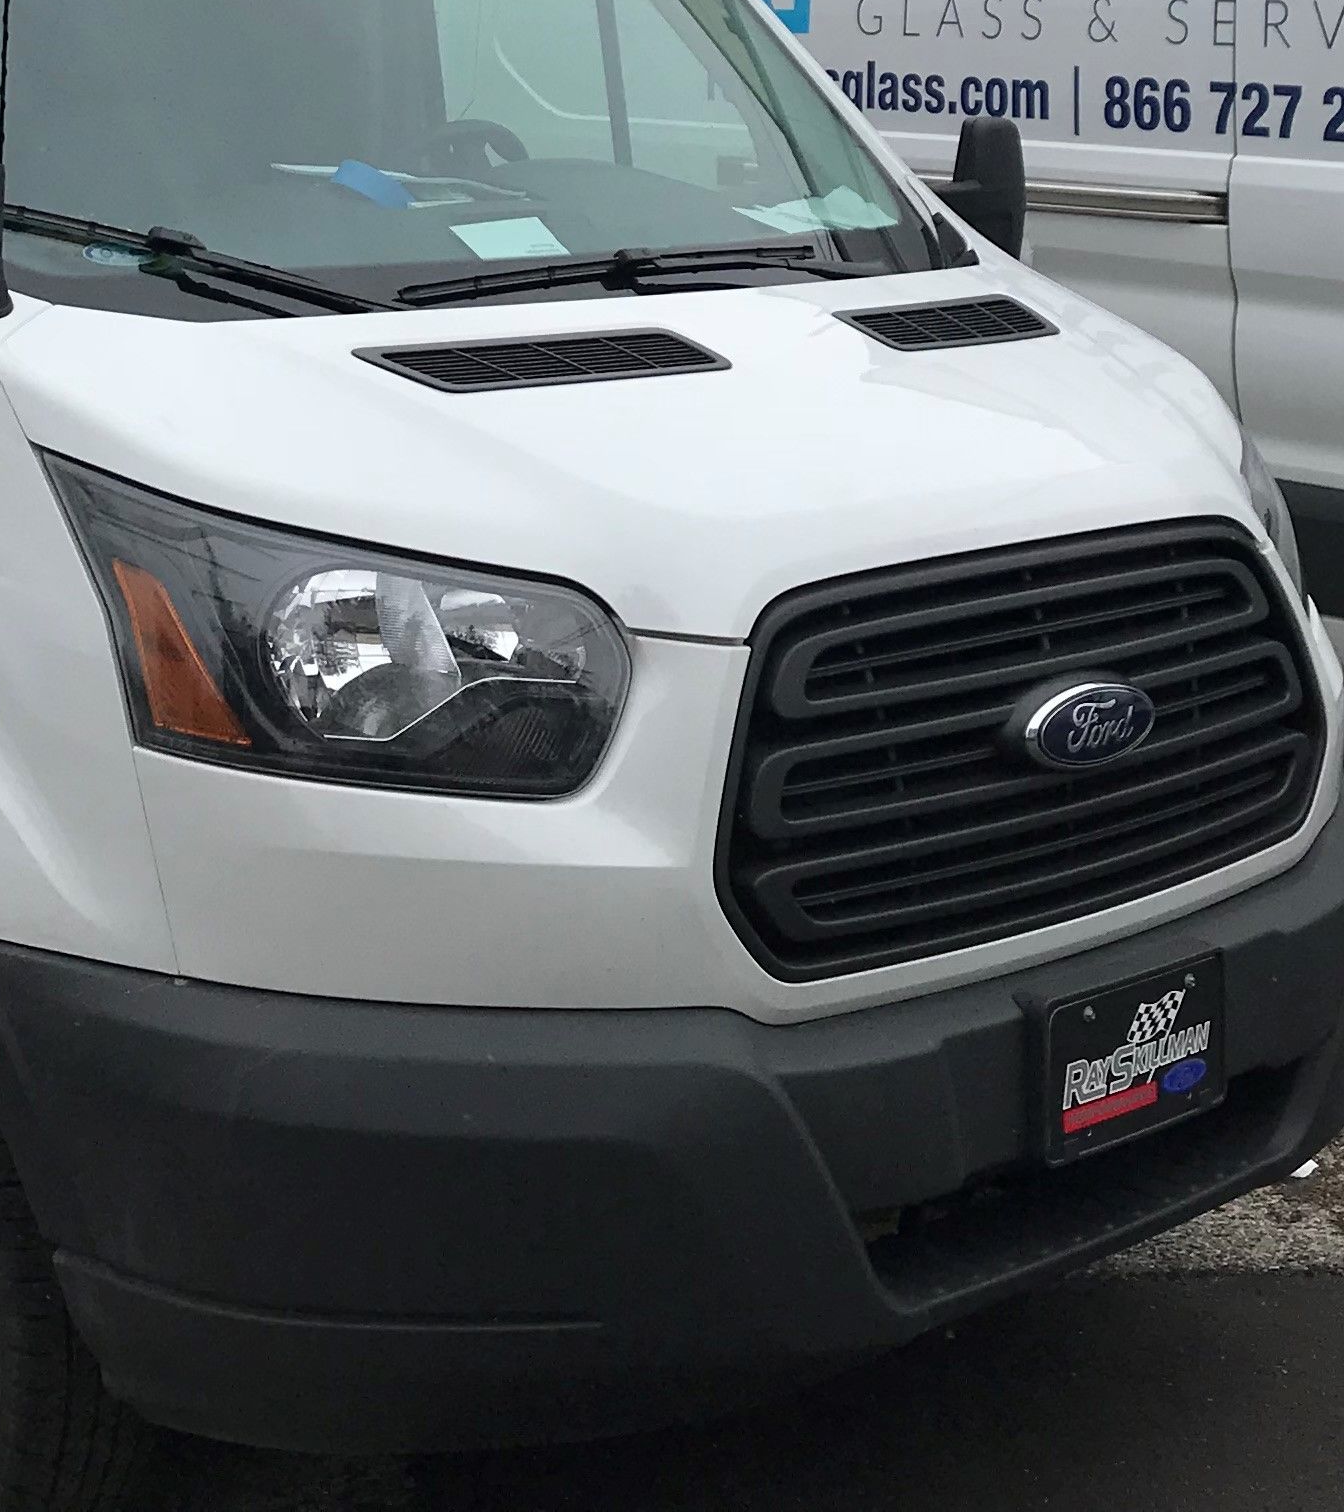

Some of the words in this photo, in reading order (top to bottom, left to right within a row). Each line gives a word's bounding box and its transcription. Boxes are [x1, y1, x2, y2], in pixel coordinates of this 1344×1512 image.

[824, 60, 1050, 121] glass.com
[1104, 77, 1192, 134] 866
[1209, 81, 1302, 140] 727
[1067, 698, 1134, 754] Ford
